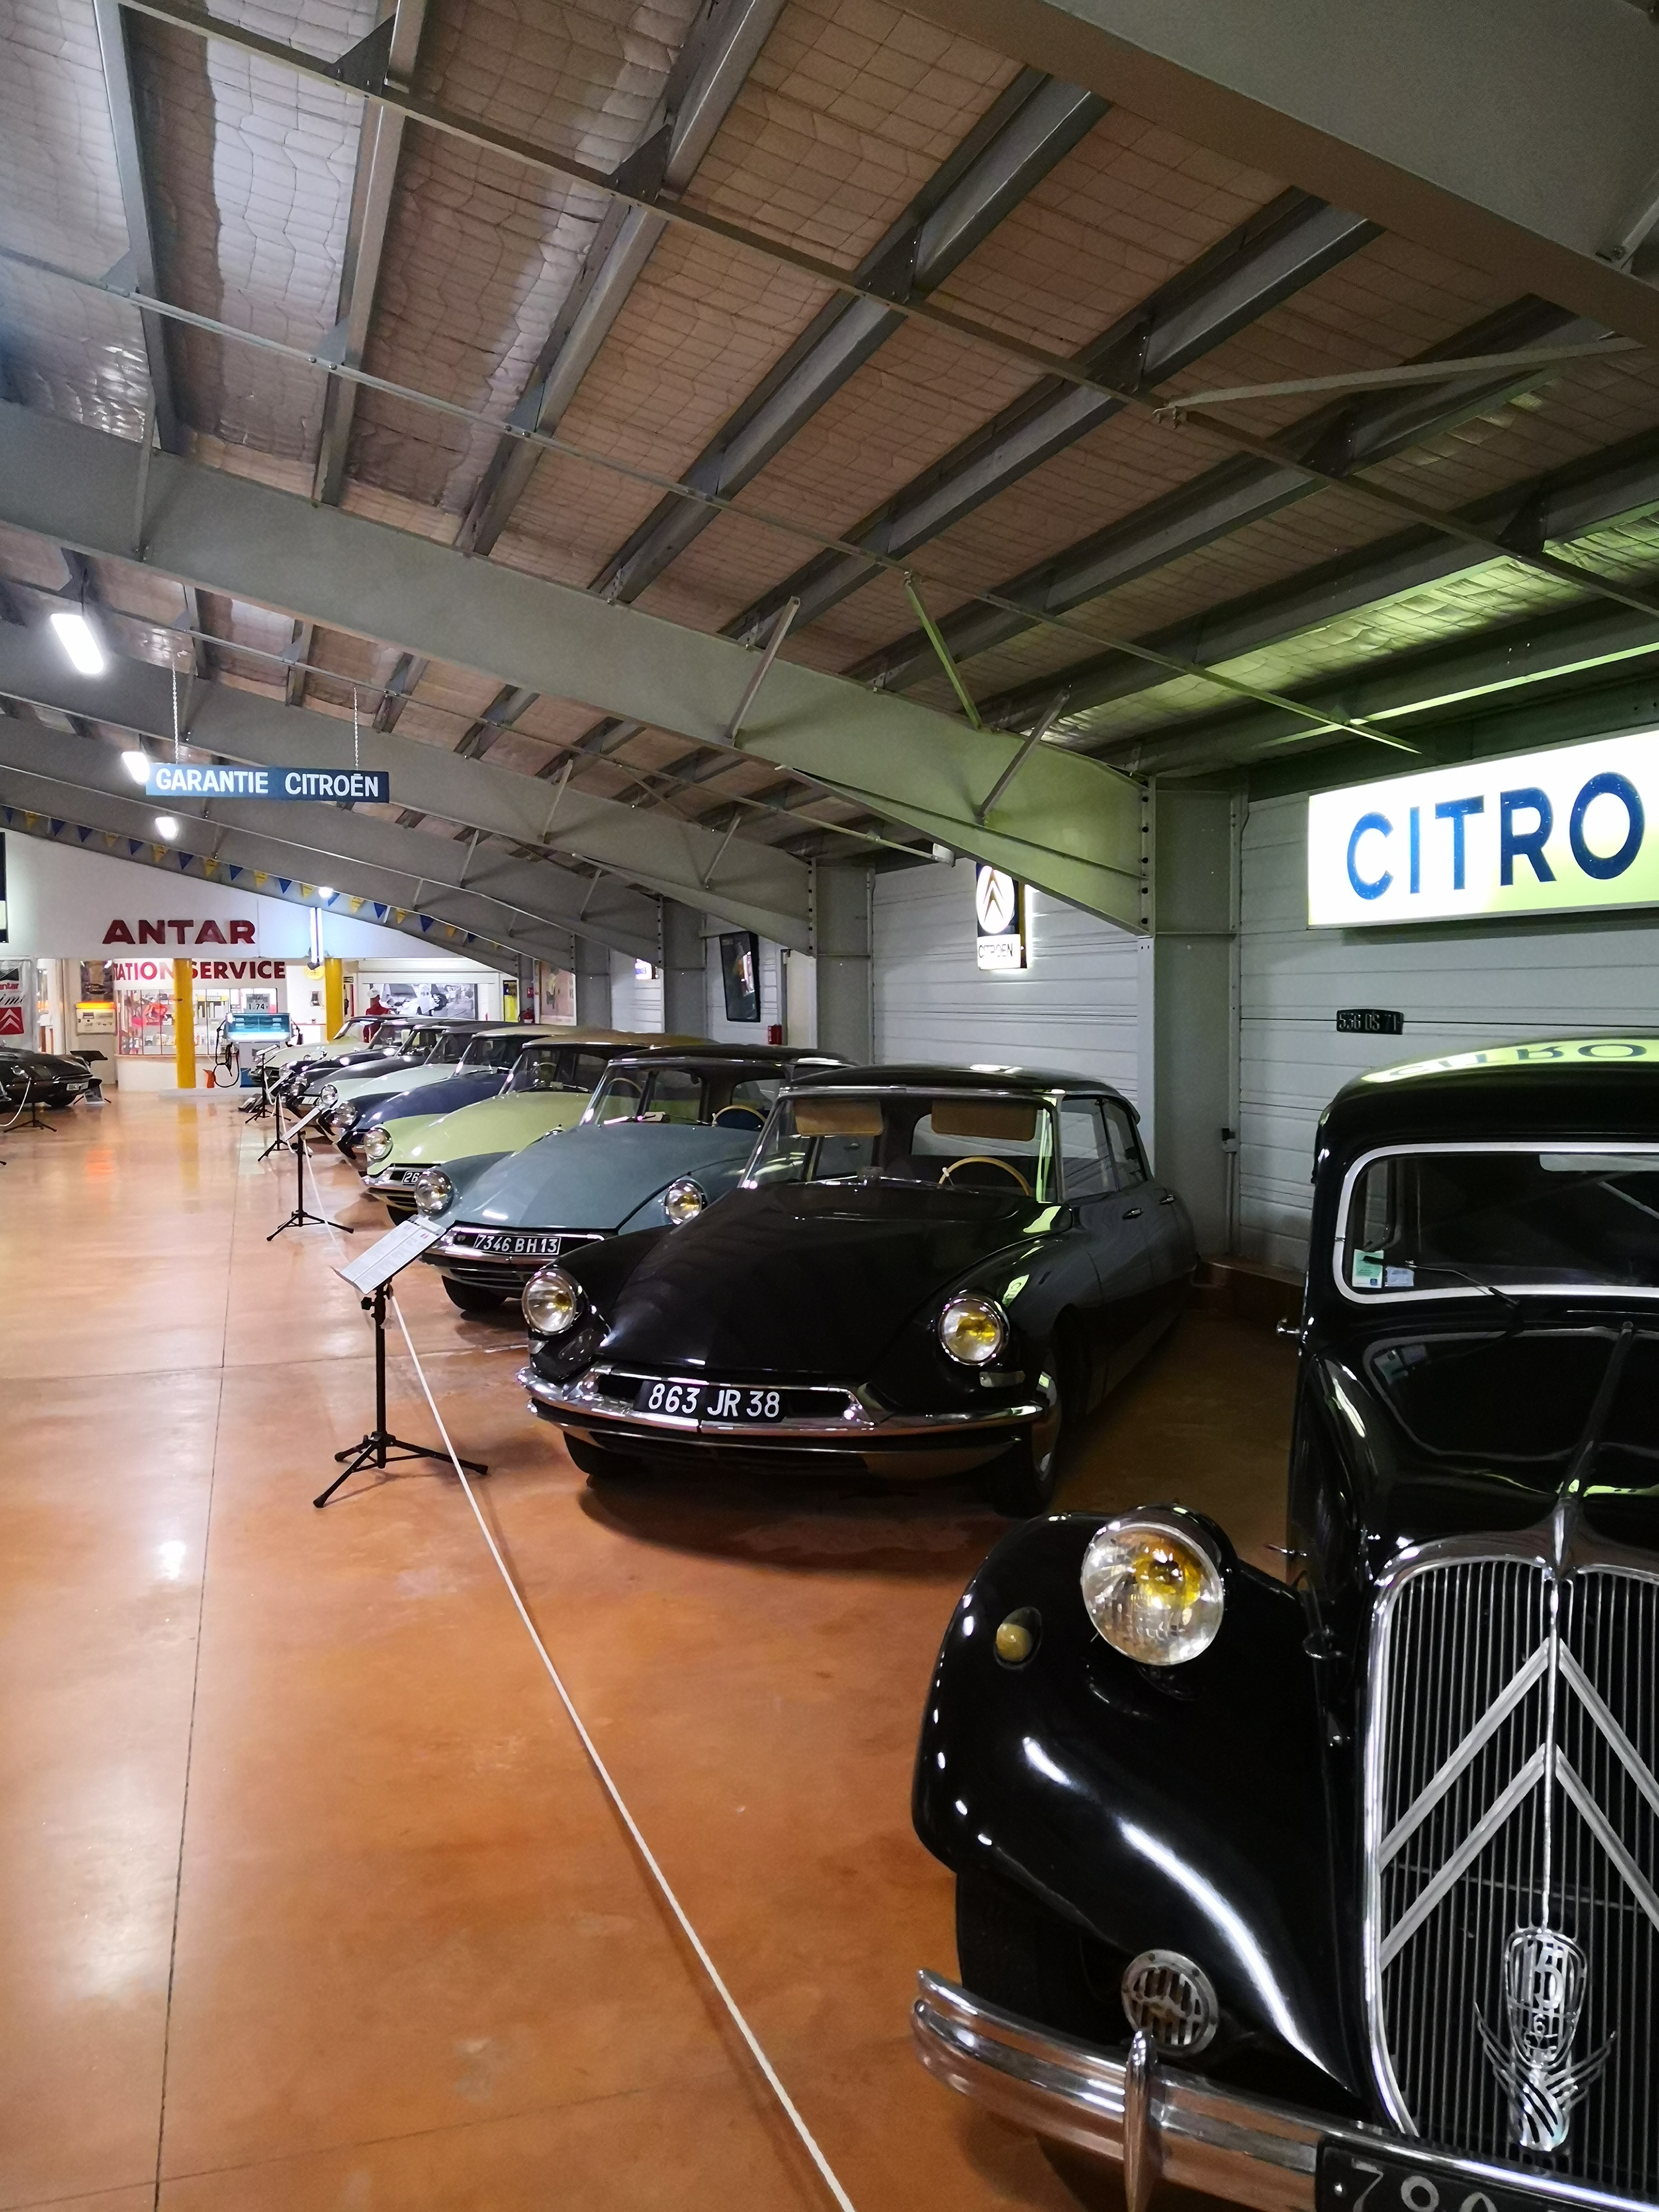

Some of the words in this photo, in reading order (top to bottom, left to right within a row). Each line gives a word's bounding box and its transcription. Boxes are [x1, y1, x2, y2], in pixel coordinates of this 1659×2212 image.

[156, 768, 269, 794] GARANTIE
[1346, 771, 1646, 900] CITRO
[102, 920, 256, 944] ANTAR
[475, 1235, 512, 1252] 7346
[648, 1383, 701, 1414] 863
[707, 1389, 741, 1417] JR
[746, 1390, 780, 1418] 38
